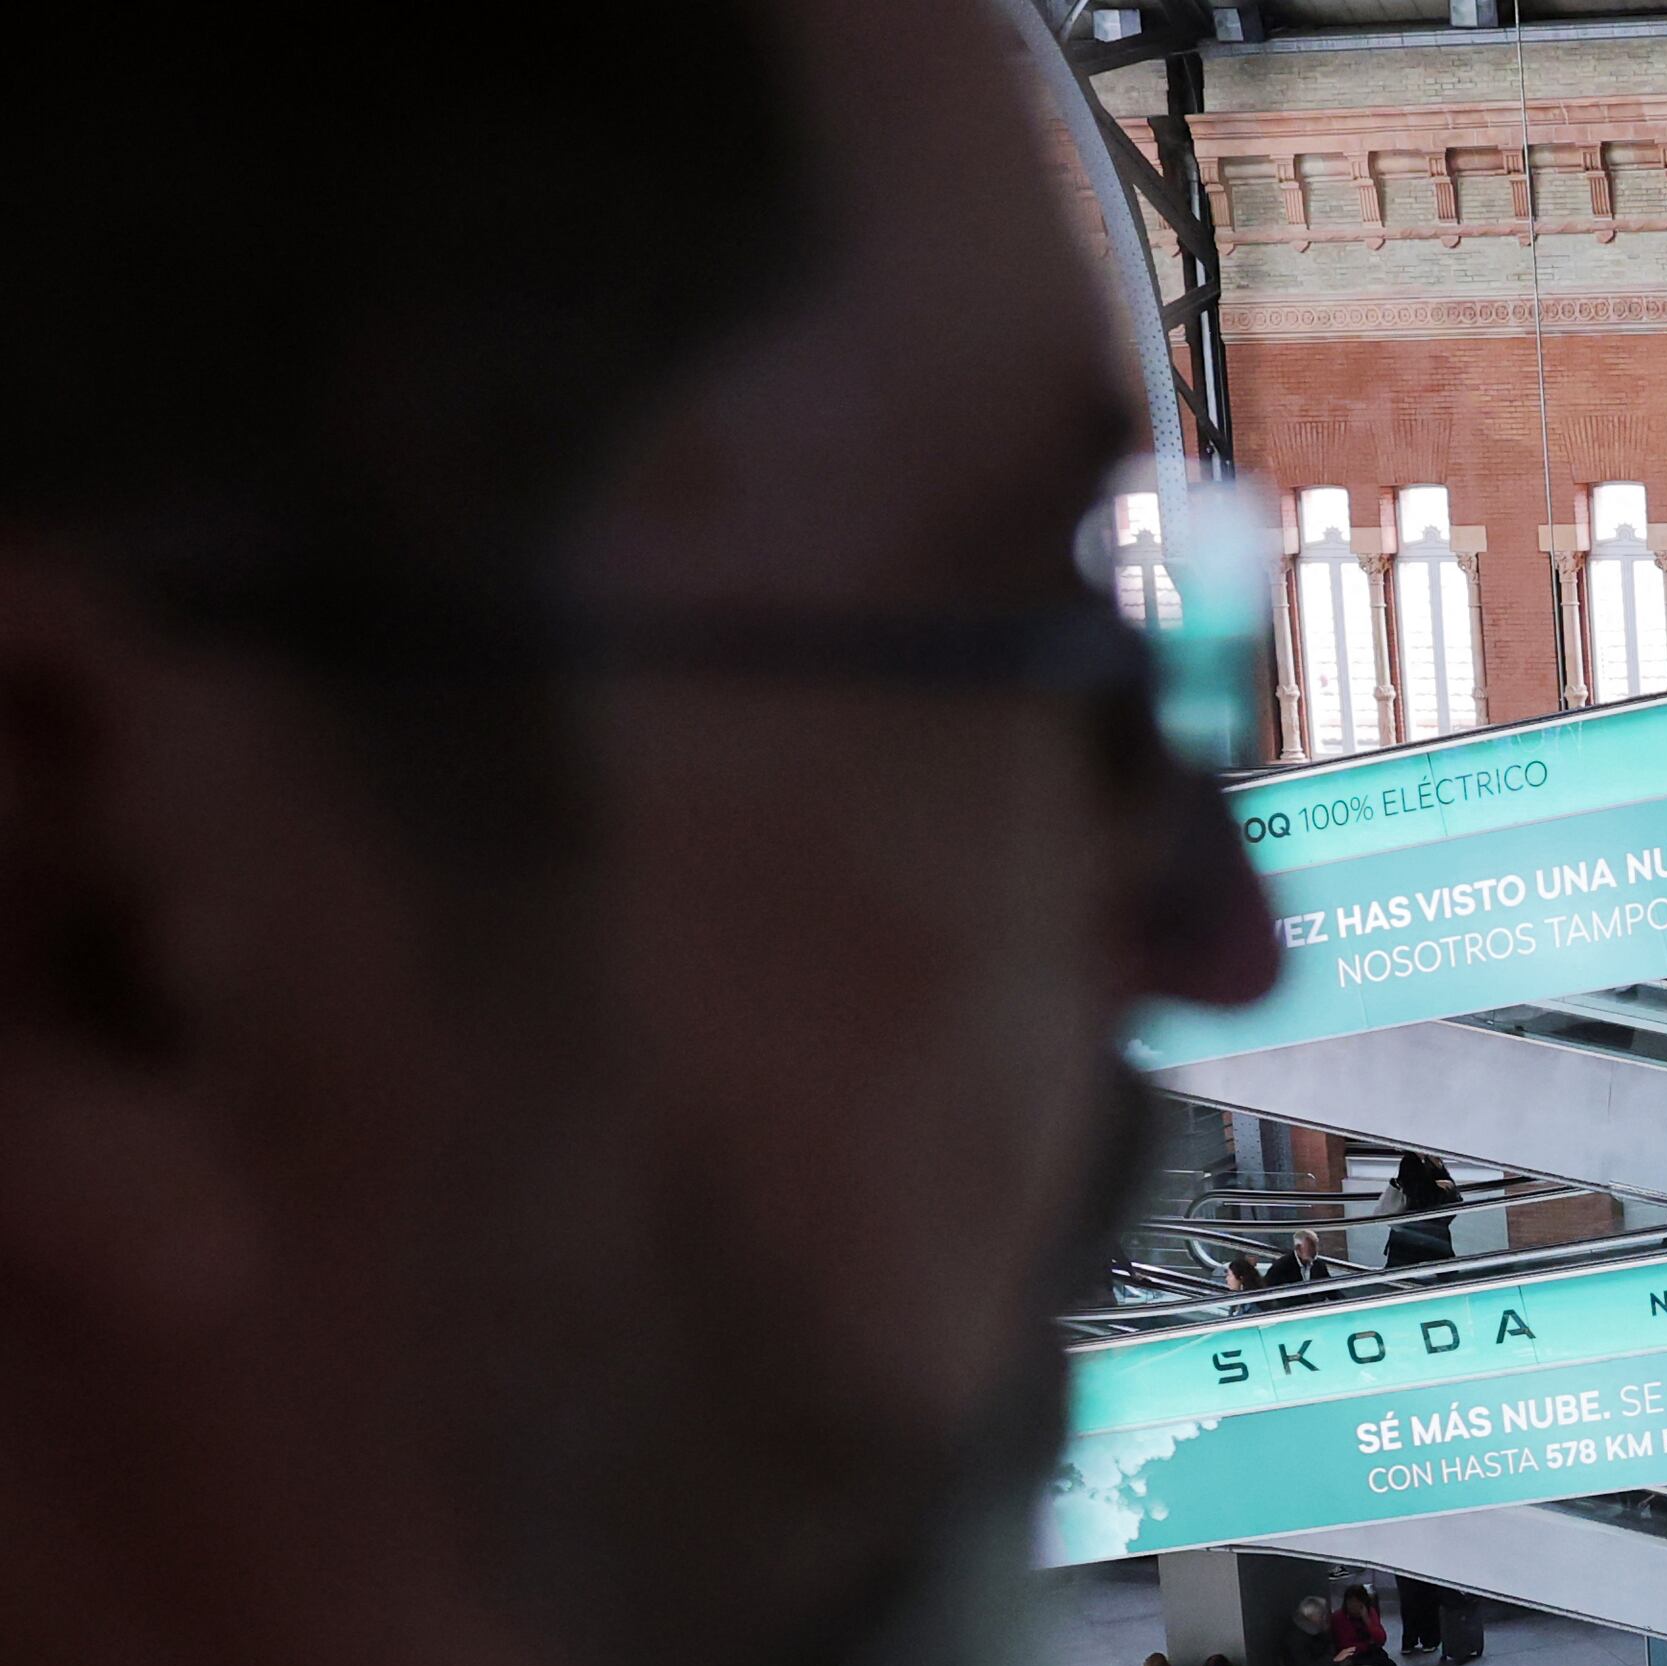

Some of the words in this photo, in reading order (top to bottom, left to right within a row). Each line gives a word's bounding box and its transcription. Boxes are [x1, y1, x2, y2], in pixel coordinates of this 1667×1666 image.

[1298, 793, 1374, 833] 100%
[1383, 760, 1549, 817] ELÉCTRICO
[1337, 896, 1411, 938] HAS
[1416, 874, 1525, 922] VISTO
[1536, 858, 1617, 901] UNA
[1337, 921, 1537, 989] NOSOTROS
[1356, 1411, 1403, 1454] SÉ
[1410, 1401, 1493, 1447] MÁS
[1501, 1390, 1611, 1434] NUBE.
[1619, 1381, 1665, 1418] SE
[1367, 1460, 1433, 1494] CON
[1440, 1447, 1540, 1484] HASTA
[1545, 1438, 1598, 1470] 578
[1605, 1431, 1653, 1462] KM
